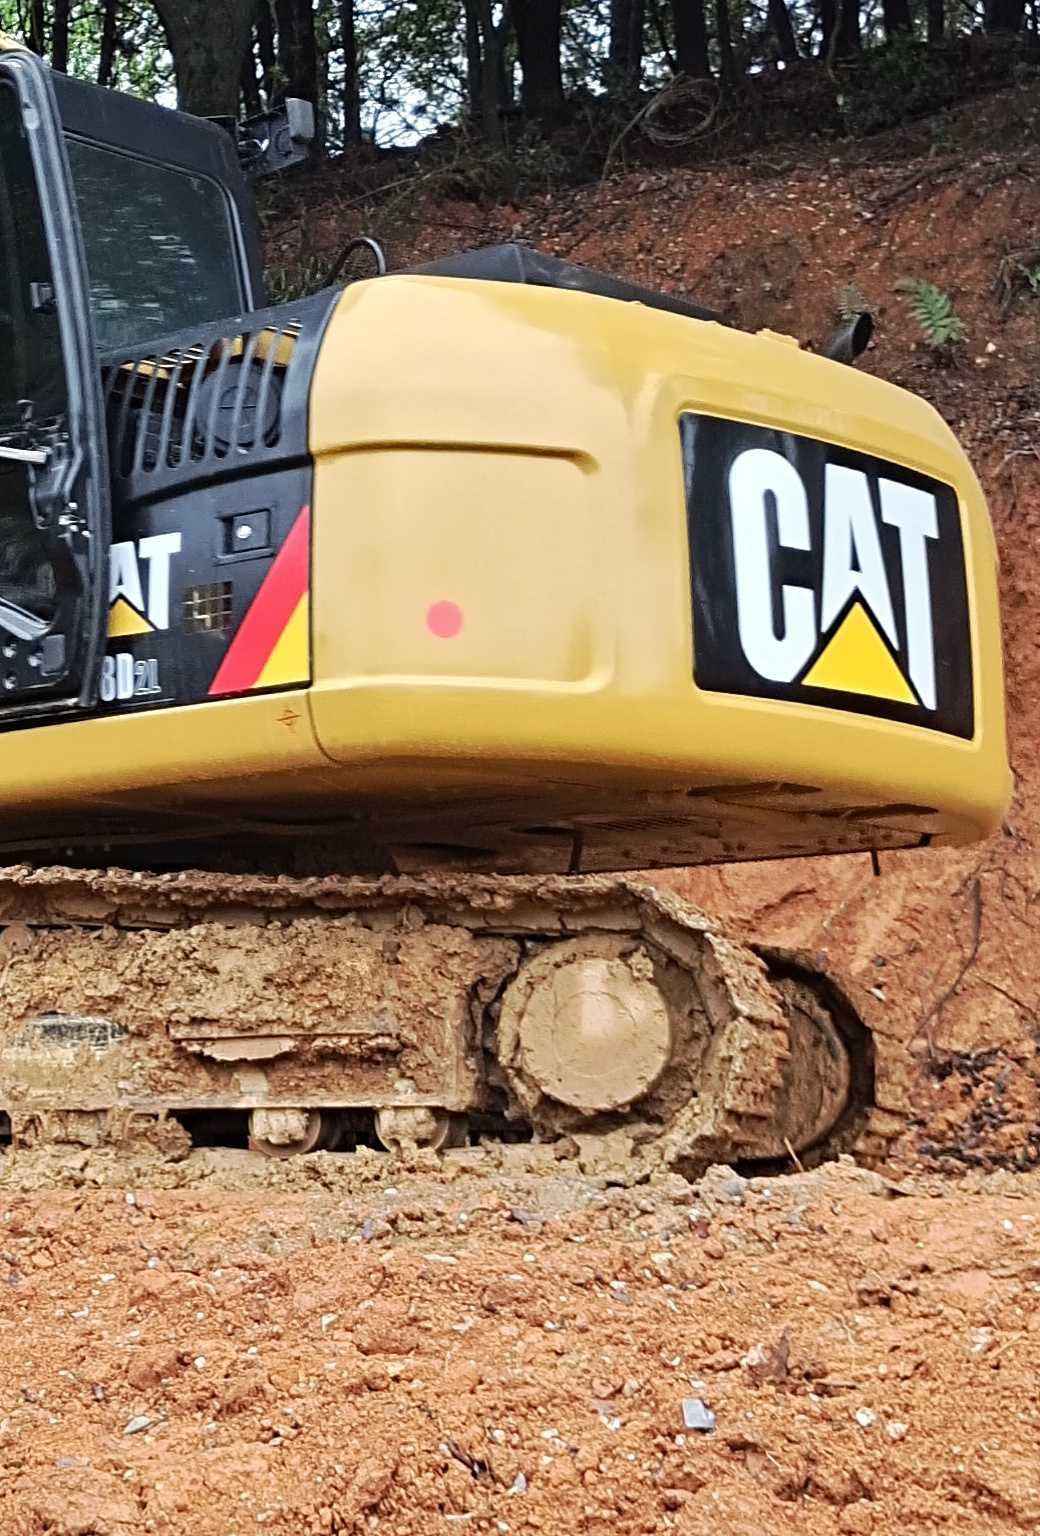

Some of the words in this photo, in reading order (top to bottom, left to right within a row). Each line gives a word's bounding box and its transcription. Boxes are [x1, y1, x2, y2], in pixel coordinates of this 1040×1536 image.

[108, 532, 182, 631] AT
[728, 448, 940, 711] CAT
[100, 652, 162, 702] 8D2L
